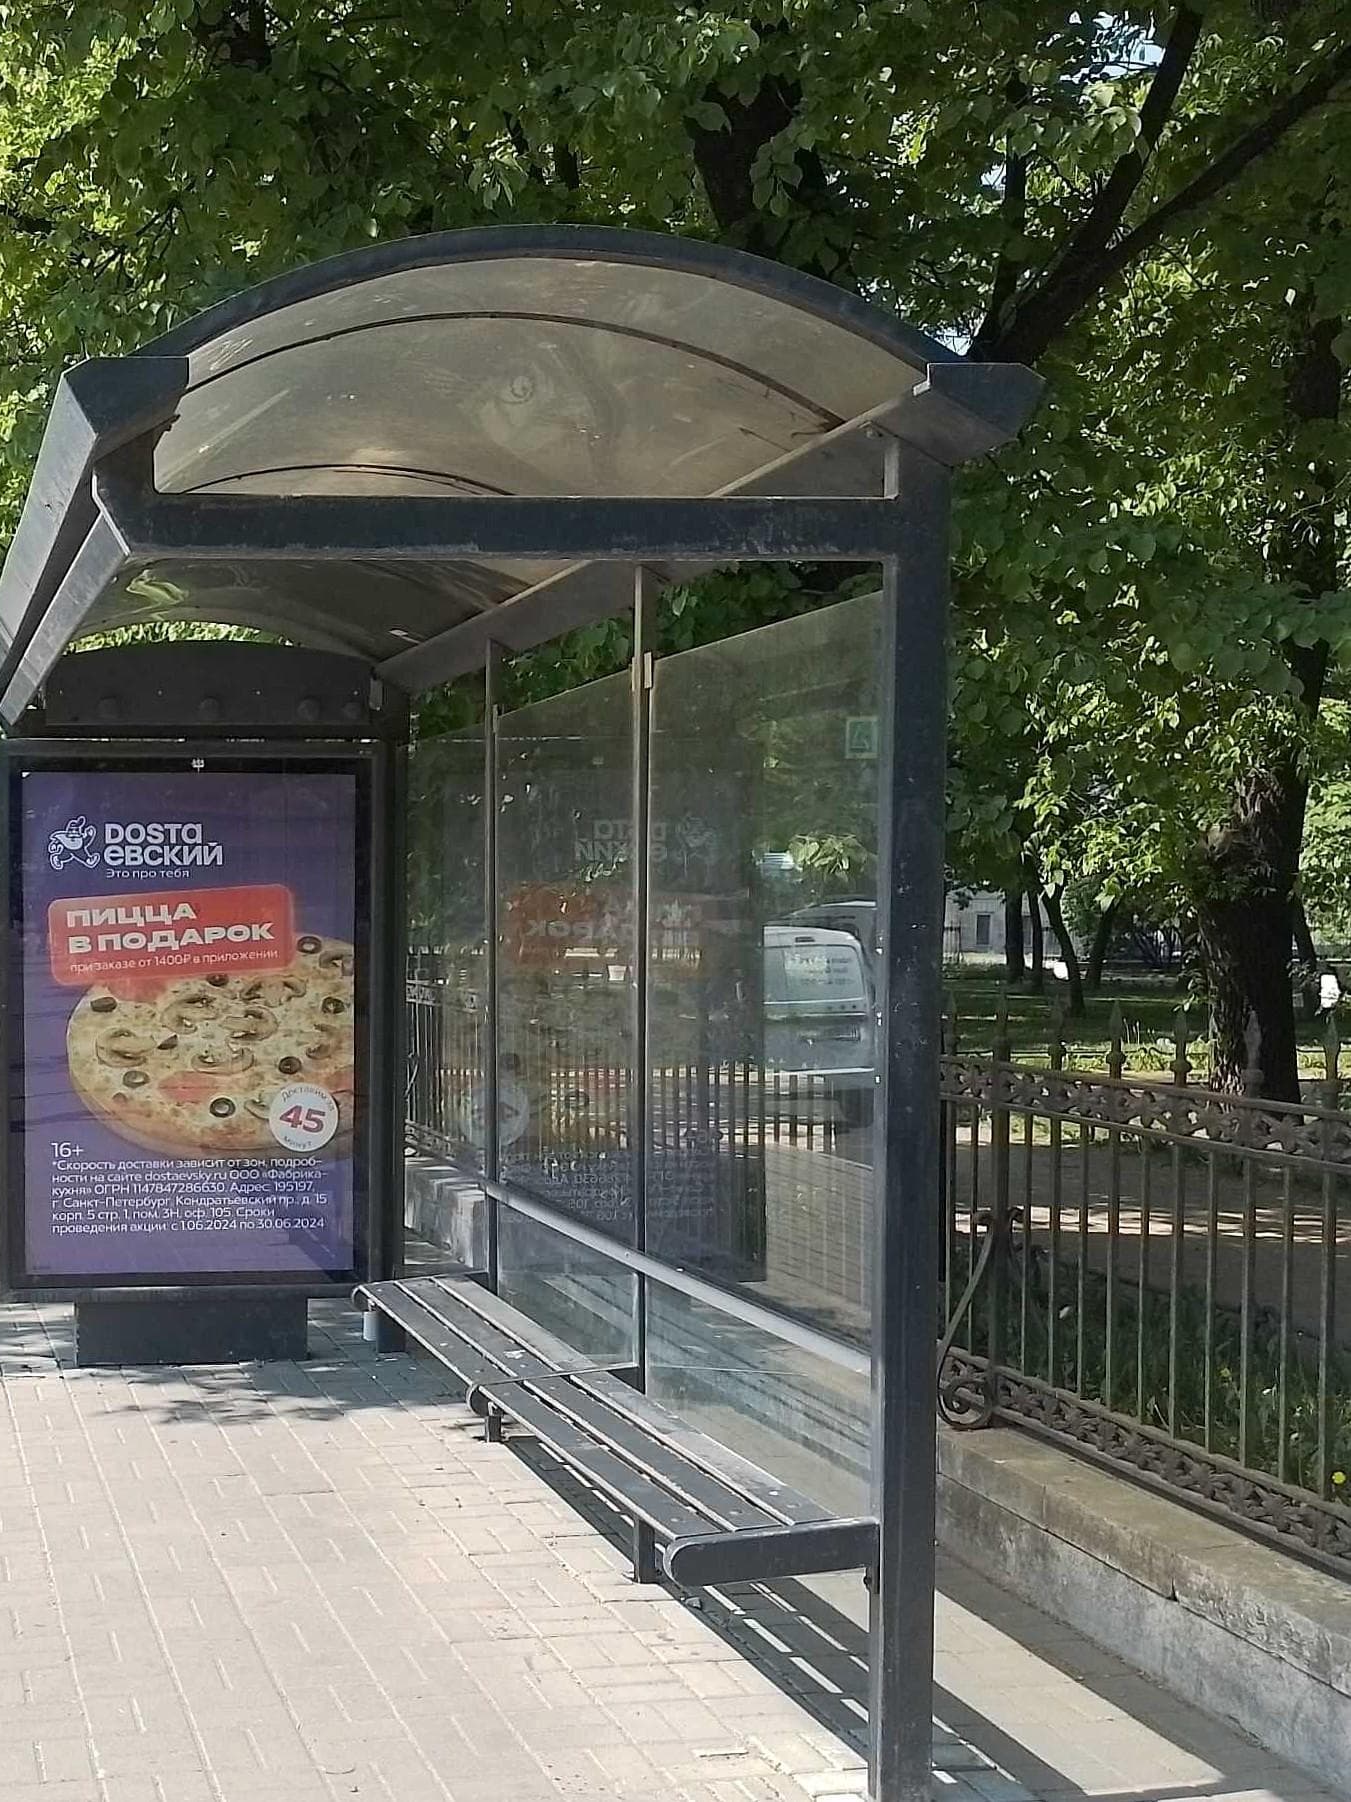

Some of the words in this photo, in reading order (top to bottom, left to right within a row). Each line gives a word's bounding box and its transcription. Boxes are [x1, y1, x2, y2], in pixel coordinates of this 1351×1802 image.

[106, 869, 130, 878] Это
[133, 870, 157, 880] про
[159, 869, 190, 878] тебя
[66, 903, 197, 927] ПИЦЦА
[68, 936, 91, 953] В
[98, 923, 275, 951] ПОДАРОК
[70, 963, 93, 975] при
[94, 960, 136, 971] заказе
[138, 959, 152, 968] от
[193, 955, 200, 963] в
[202, 950, 279, 965] приложении
[279, 1105, 326, 1133] 45
[51, 1142, 84, 1158] 16+
[117, 1160, 174, 1171] доставки
[176, 1159, 225, 1169] зависит
[227, 1159, 241, 1168] от
[270, 1156, 323, 1168] подроб-
[52, 1175, 87, 1183] ности
[229, 1169, 259, 1179] ООО
[94, 1184, 129, 1195] ОГРН
[236, 1206, 275, 1220] Сроки
[52, 1223, 128, 1236] проведения
[171, 1222, 179, 1231] с
[239, 1220, 255, 1230] по
